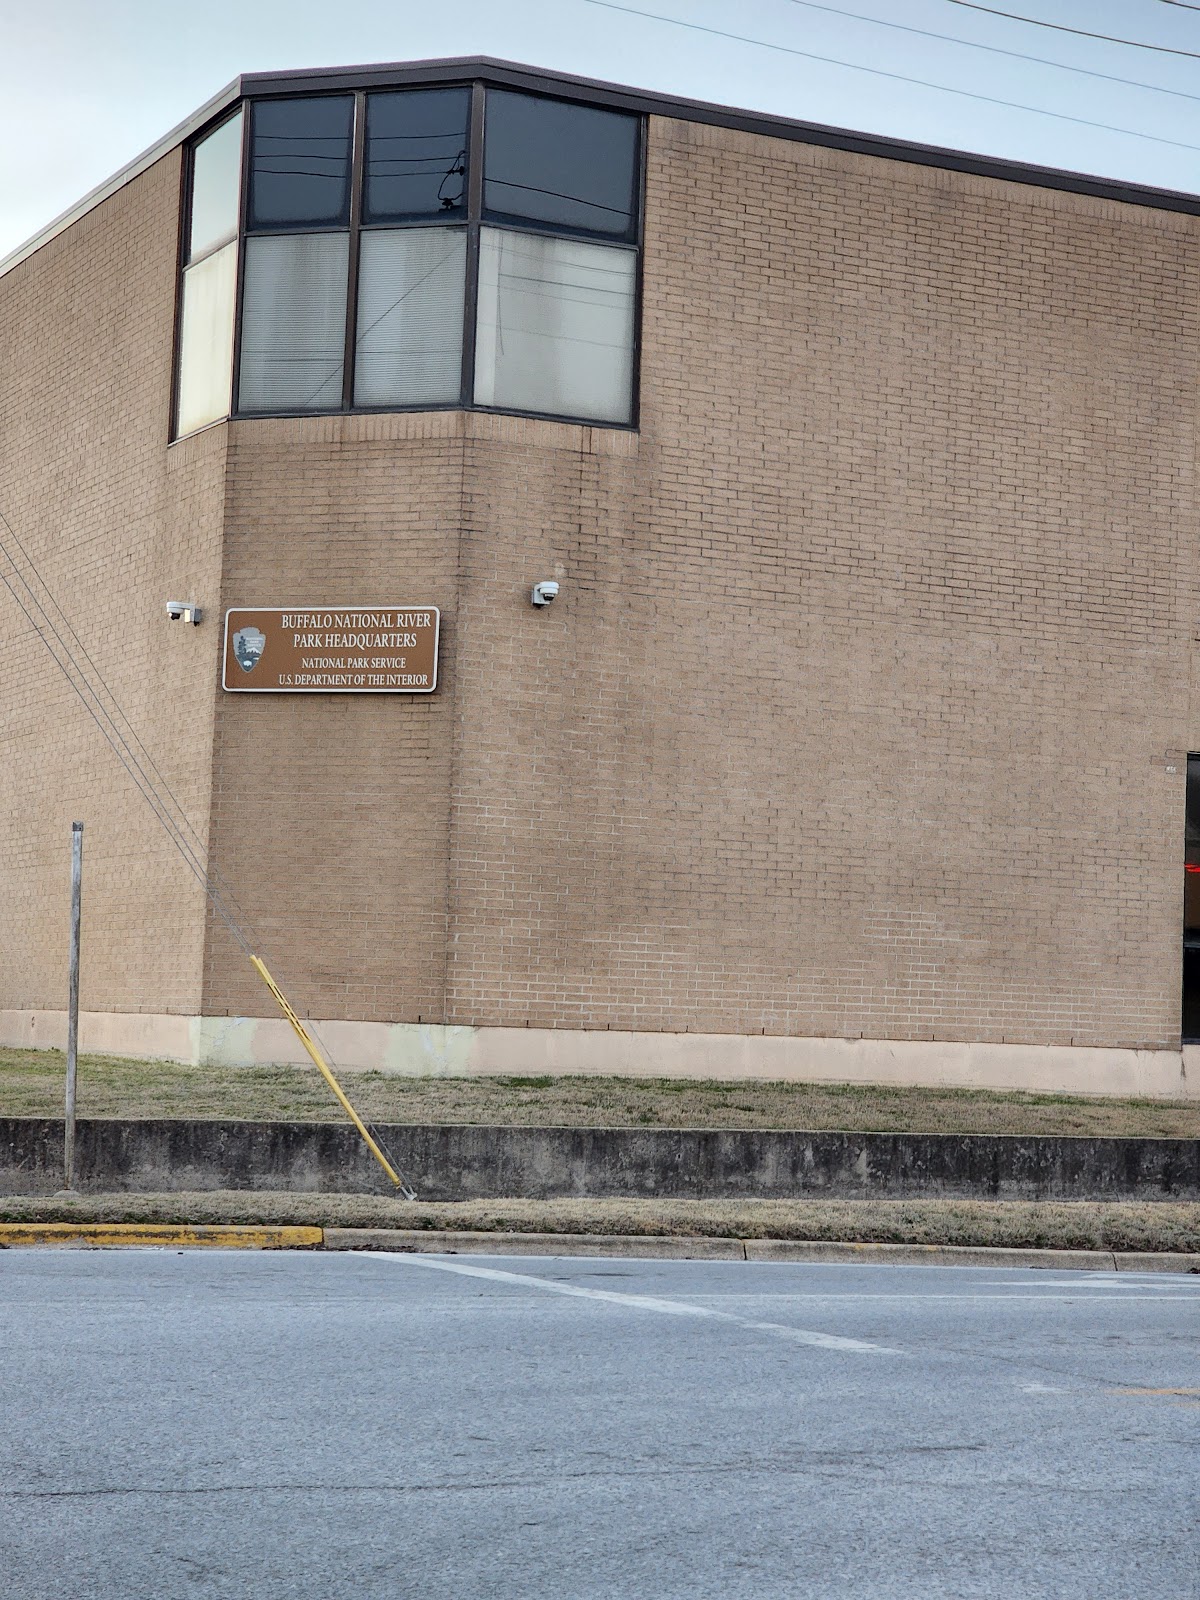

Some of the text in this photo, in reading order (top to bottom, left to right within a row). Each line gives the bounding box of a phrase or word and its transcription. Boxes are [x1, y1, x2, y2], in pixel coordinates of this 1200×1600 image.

[281, 613, 431, 629] BUFFALO NATIONAL RIVER
[293, 633, 417, 650] PARK HEADQUARTERS
[302, 657, 406, 669] NATIONAL PARK SERVICE
[279, 674, 428, 686] U.S. DEPARTMENT OF THE INTERIOR
